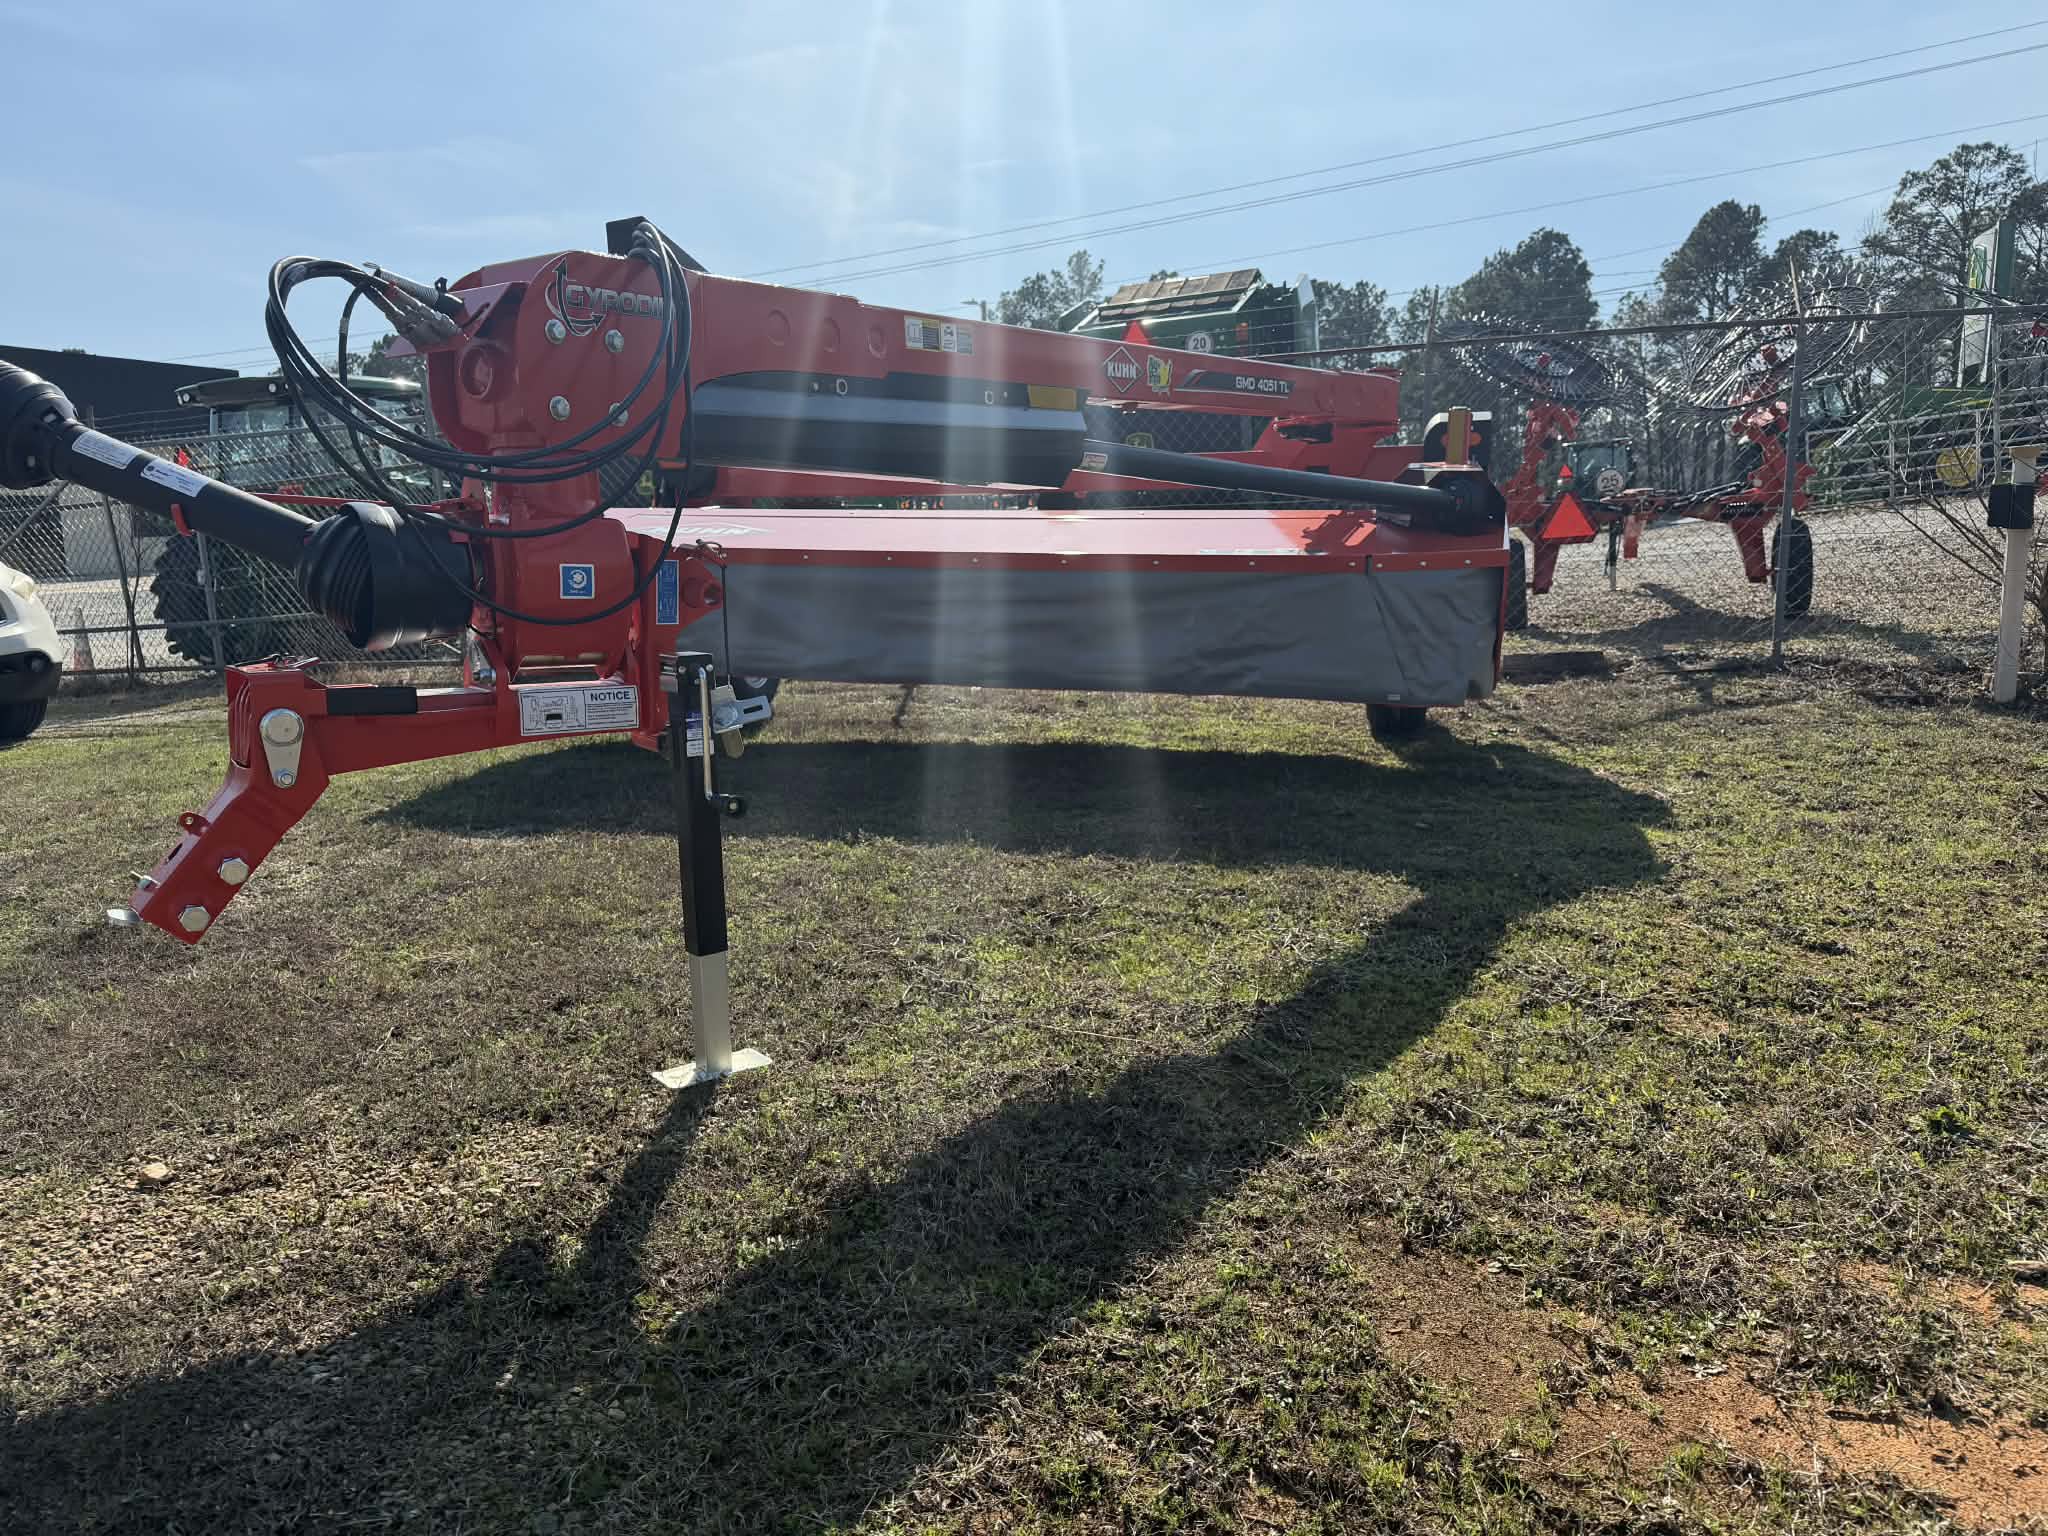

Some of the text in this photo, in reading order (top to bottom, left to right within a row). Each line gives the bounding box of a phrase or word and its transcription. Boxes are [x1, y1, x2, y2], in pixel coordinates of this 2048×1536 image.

[1192, 336, 1207, 350] 20
[1107, 360, 1137, 379] KUHN
[1235, 376, 1290, 393] GMD 4051 TL
[1601, 473, 1619, 489] 25
[590, 690, 631, 701] NOTICE
